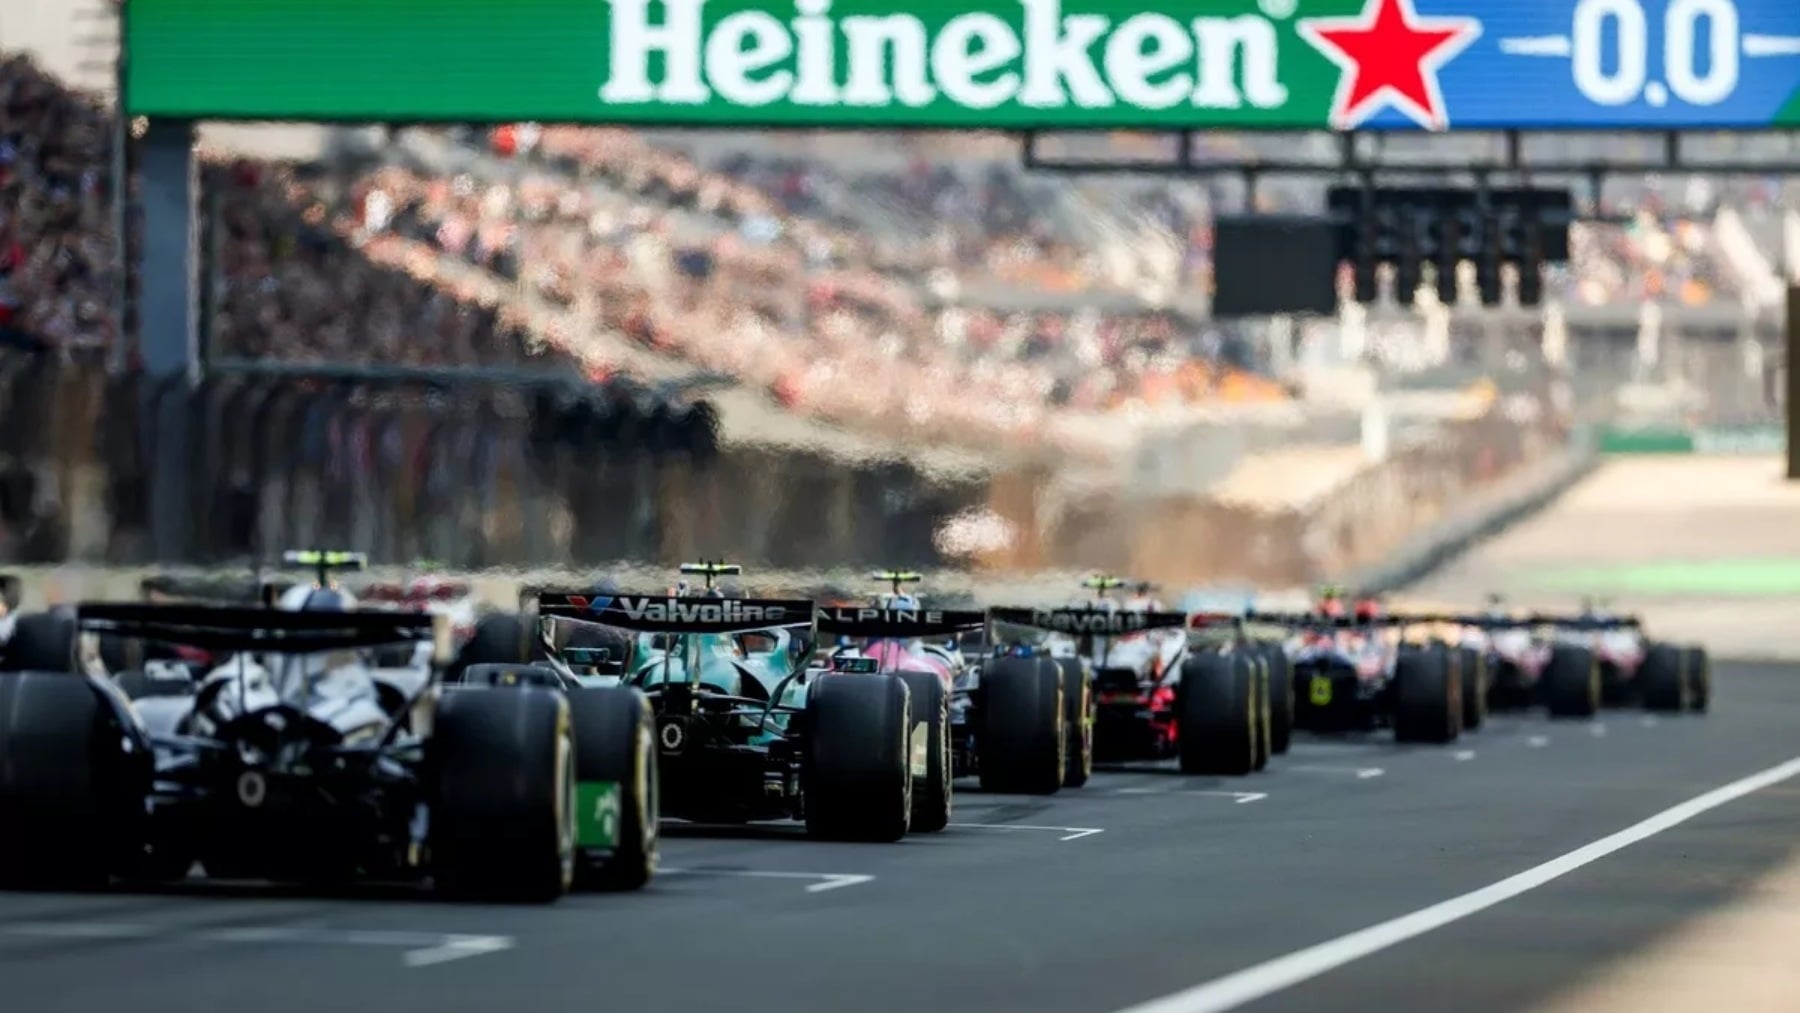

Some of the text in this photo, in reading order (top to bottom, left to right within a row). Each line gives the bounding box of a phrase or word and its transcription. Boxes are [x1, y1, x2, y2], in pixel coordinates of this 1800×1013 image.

[600, 0, 1288, 106] Heineken
[619, 597, 787, 623] Valvoline
[816, 608, 943, 624] ALPINE
